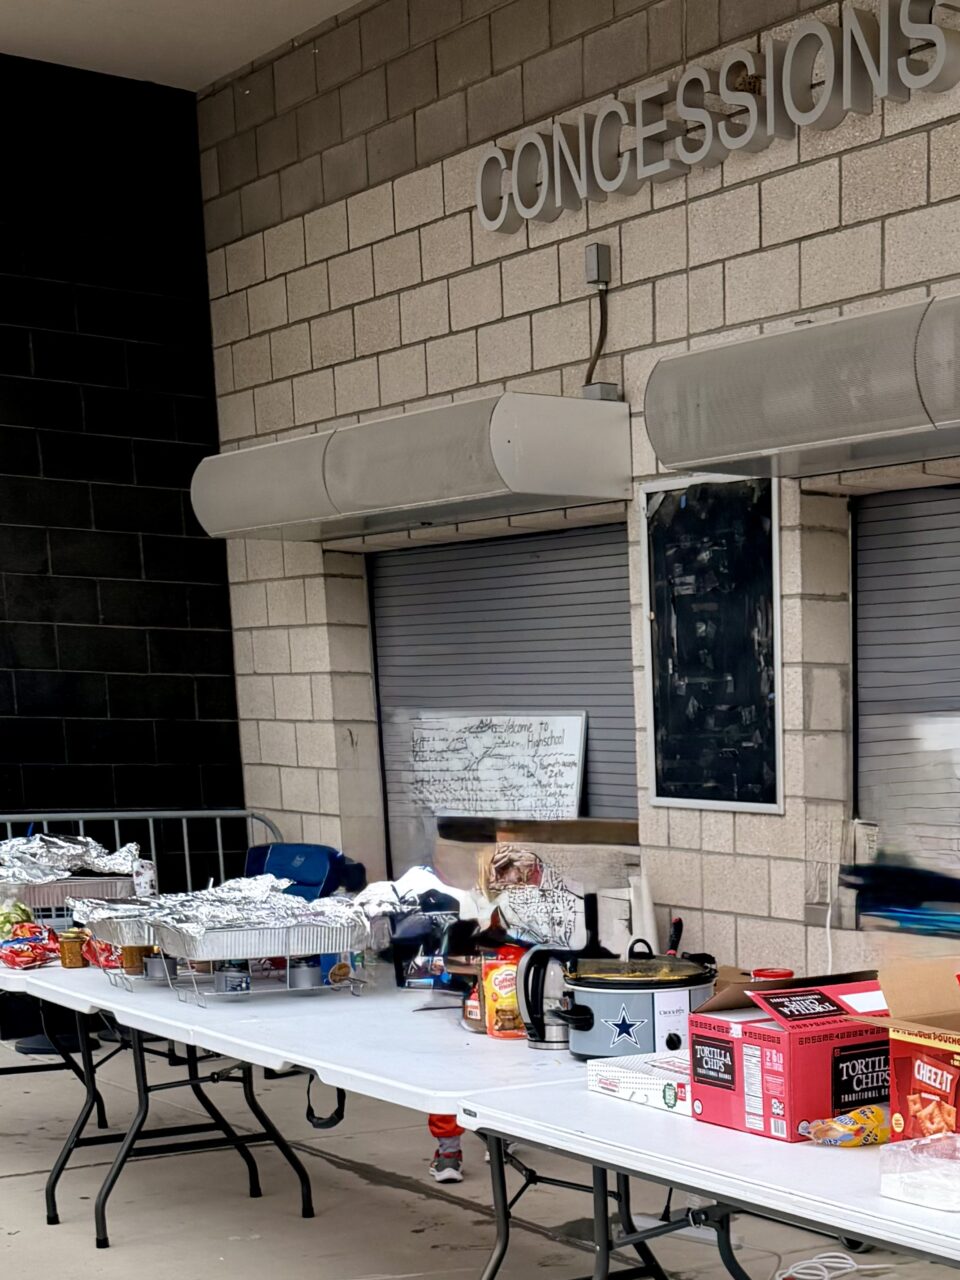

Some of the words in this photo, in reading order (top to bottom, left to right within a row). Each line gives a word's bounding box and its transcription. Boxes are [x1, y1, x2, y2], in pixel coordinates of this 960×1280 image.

[694, 1045, 732, 1065] TORTILLA
[702, 1056, 725, 1072] CHIPS
[839, 1056, 890, 1081] TORTIL
[853, 1071, 890, 1091] CHIPS
[841, 1089, 879, 1103] TRADITIONAL
